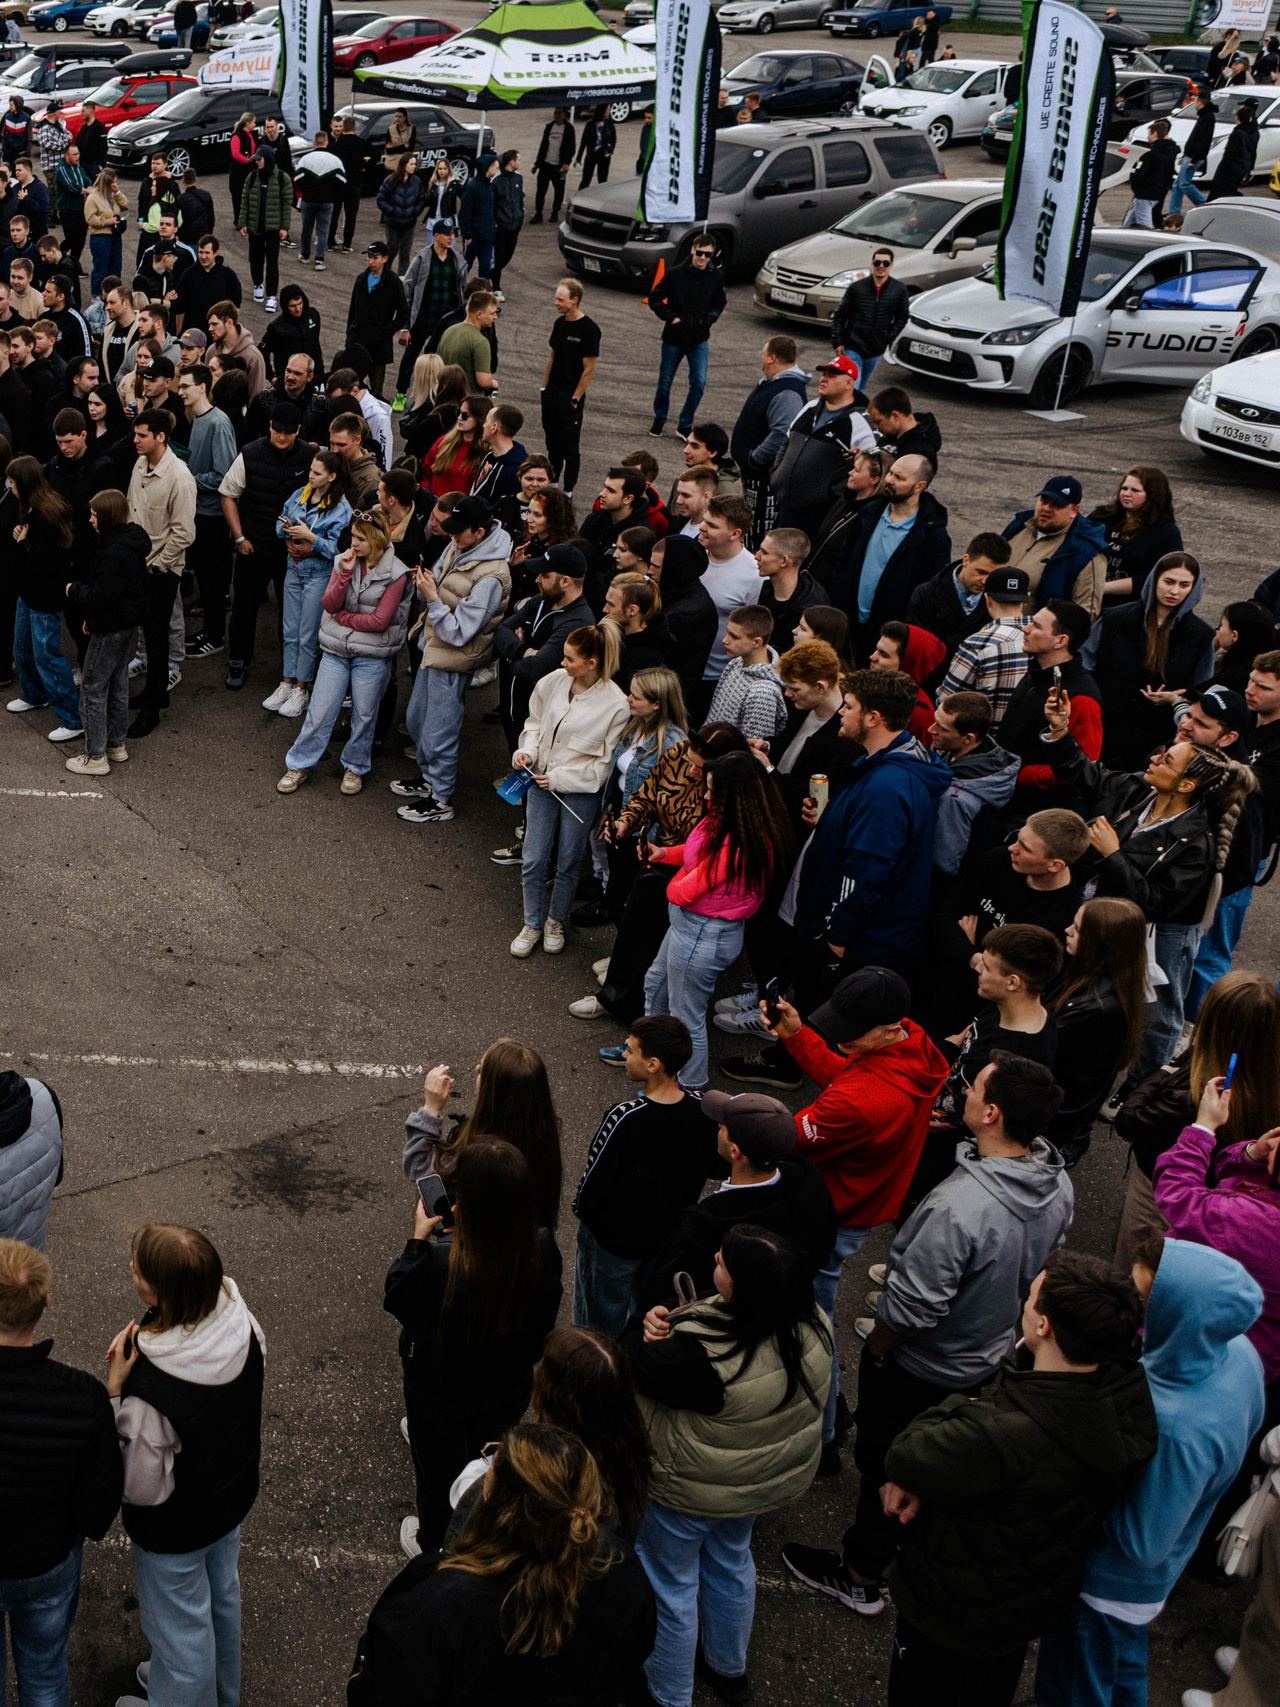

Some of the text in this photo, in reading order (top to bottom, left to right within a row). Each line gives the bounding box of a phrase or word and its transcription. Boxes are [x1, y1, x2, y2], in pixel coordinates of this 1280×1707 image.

[1040, 16, 1059, 129] WE CREATE SOUND
[566, 86, 642, 99] http://deafbonce.com
[1075, 96, 1106, 258] RUSSIAN INNOVATIVE TECHNOLOGIES
[1106, 331, 1216, 352] STUDIO
[1216, 425, 1268, 445] У103ВВ 152
